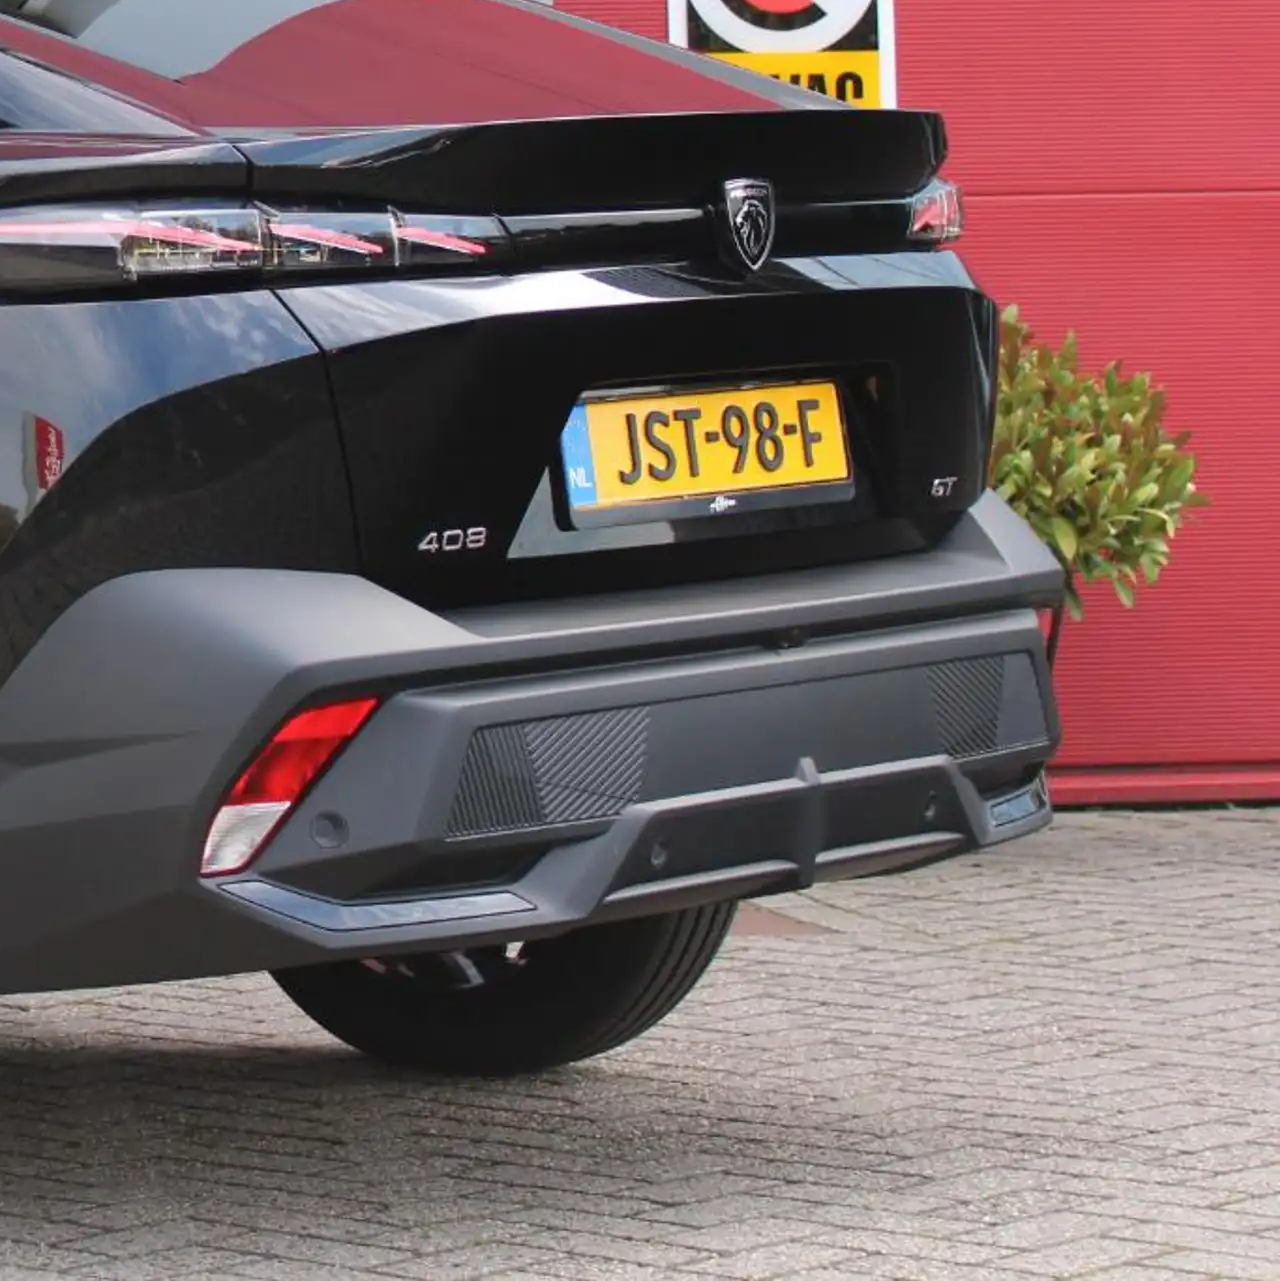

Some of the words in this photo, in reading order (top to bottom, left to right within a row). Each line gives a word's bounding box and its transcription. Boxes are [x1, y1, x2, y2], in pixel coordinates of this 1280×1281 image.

[619, 399, 822, 485] JST-98-F
[569, 466, 593, 489] NL
[931, 476, 959, 497] GT
[417, 526, 487, 553] 408
